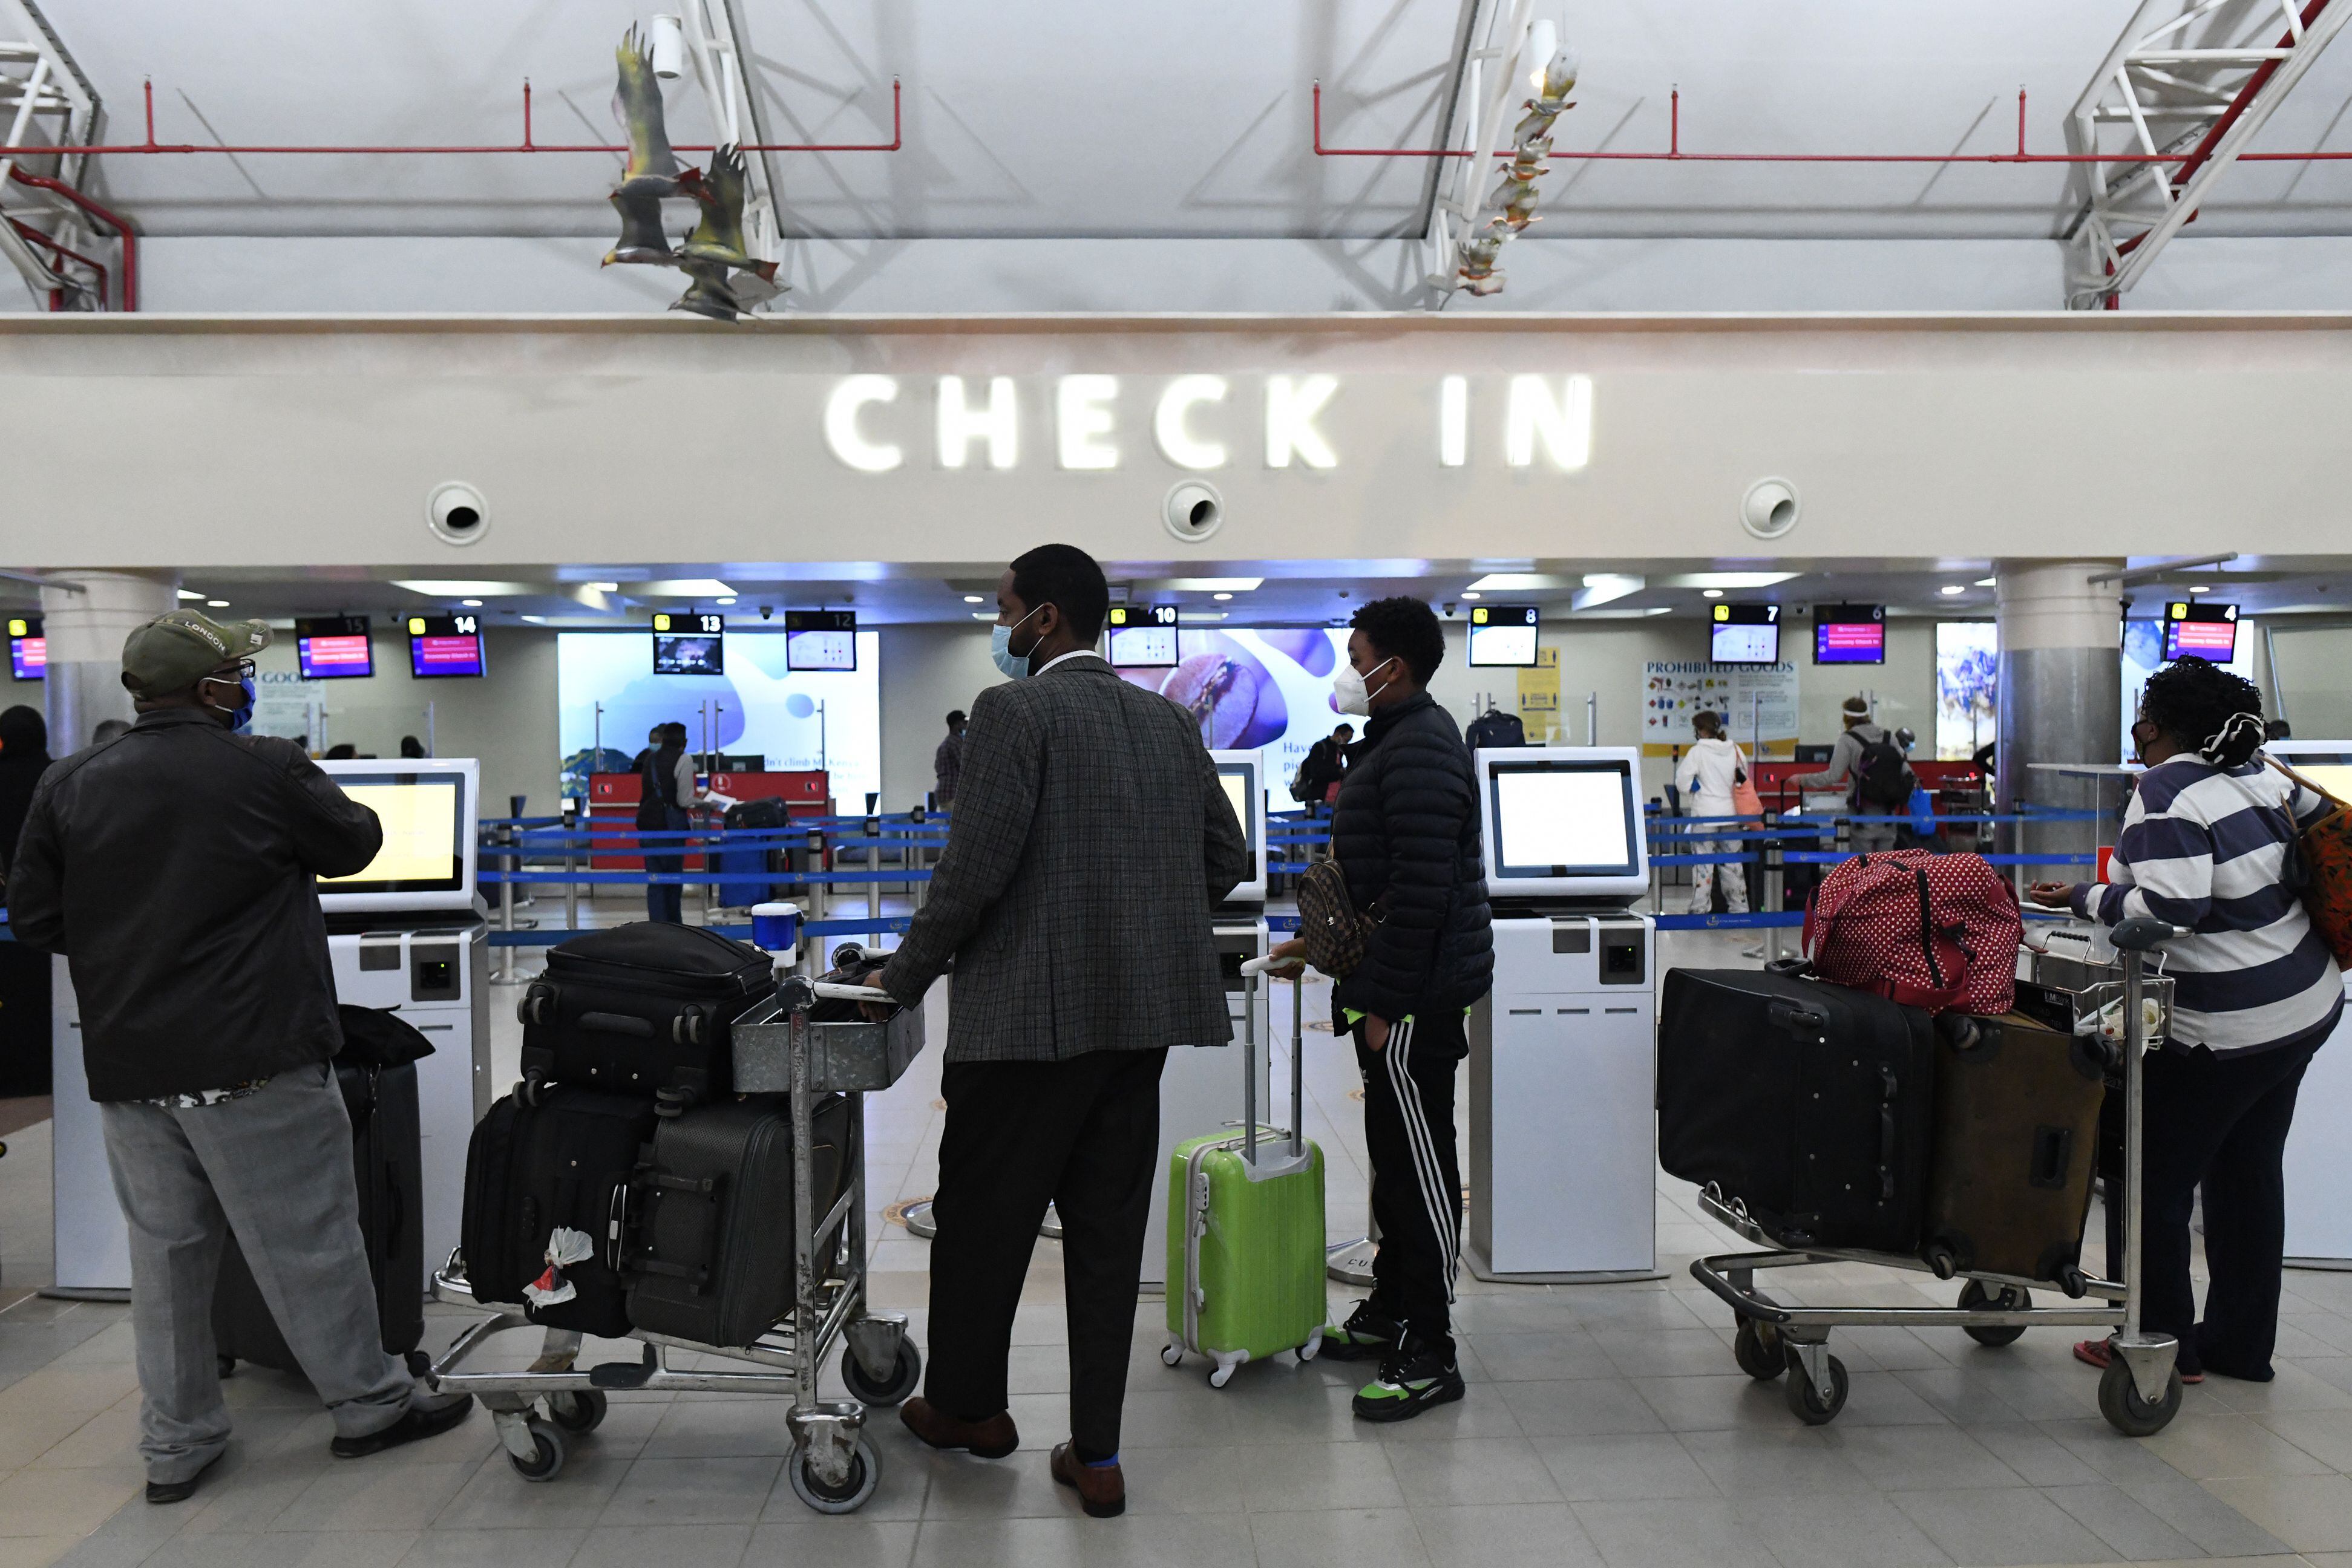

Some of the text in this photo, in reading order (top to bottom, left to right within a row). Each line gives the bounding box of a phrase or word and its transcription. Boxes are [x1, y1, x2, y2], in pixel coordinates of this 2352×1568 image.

[824, 373, 1593, 471] CHECK IN
[834, 614, 851, 627] 12
[1155, 607, 1176, 623] 10
[1525, 608, 1536, 624] 8
[1767, 606, 1778, 622] 7
[1873, 606, 1882, 619] 6
[2224, 605, 2236, 621] 4
[344, 618, 364, 633] 15
[454, 616, 476, 633] 14
[700, 615, 721, 632] 13
[185, 621, 226, 652] LONDON
[1647, 661, 1794, 673] PROHIBITED GOODS
[785, 757, 810, 766] climb
